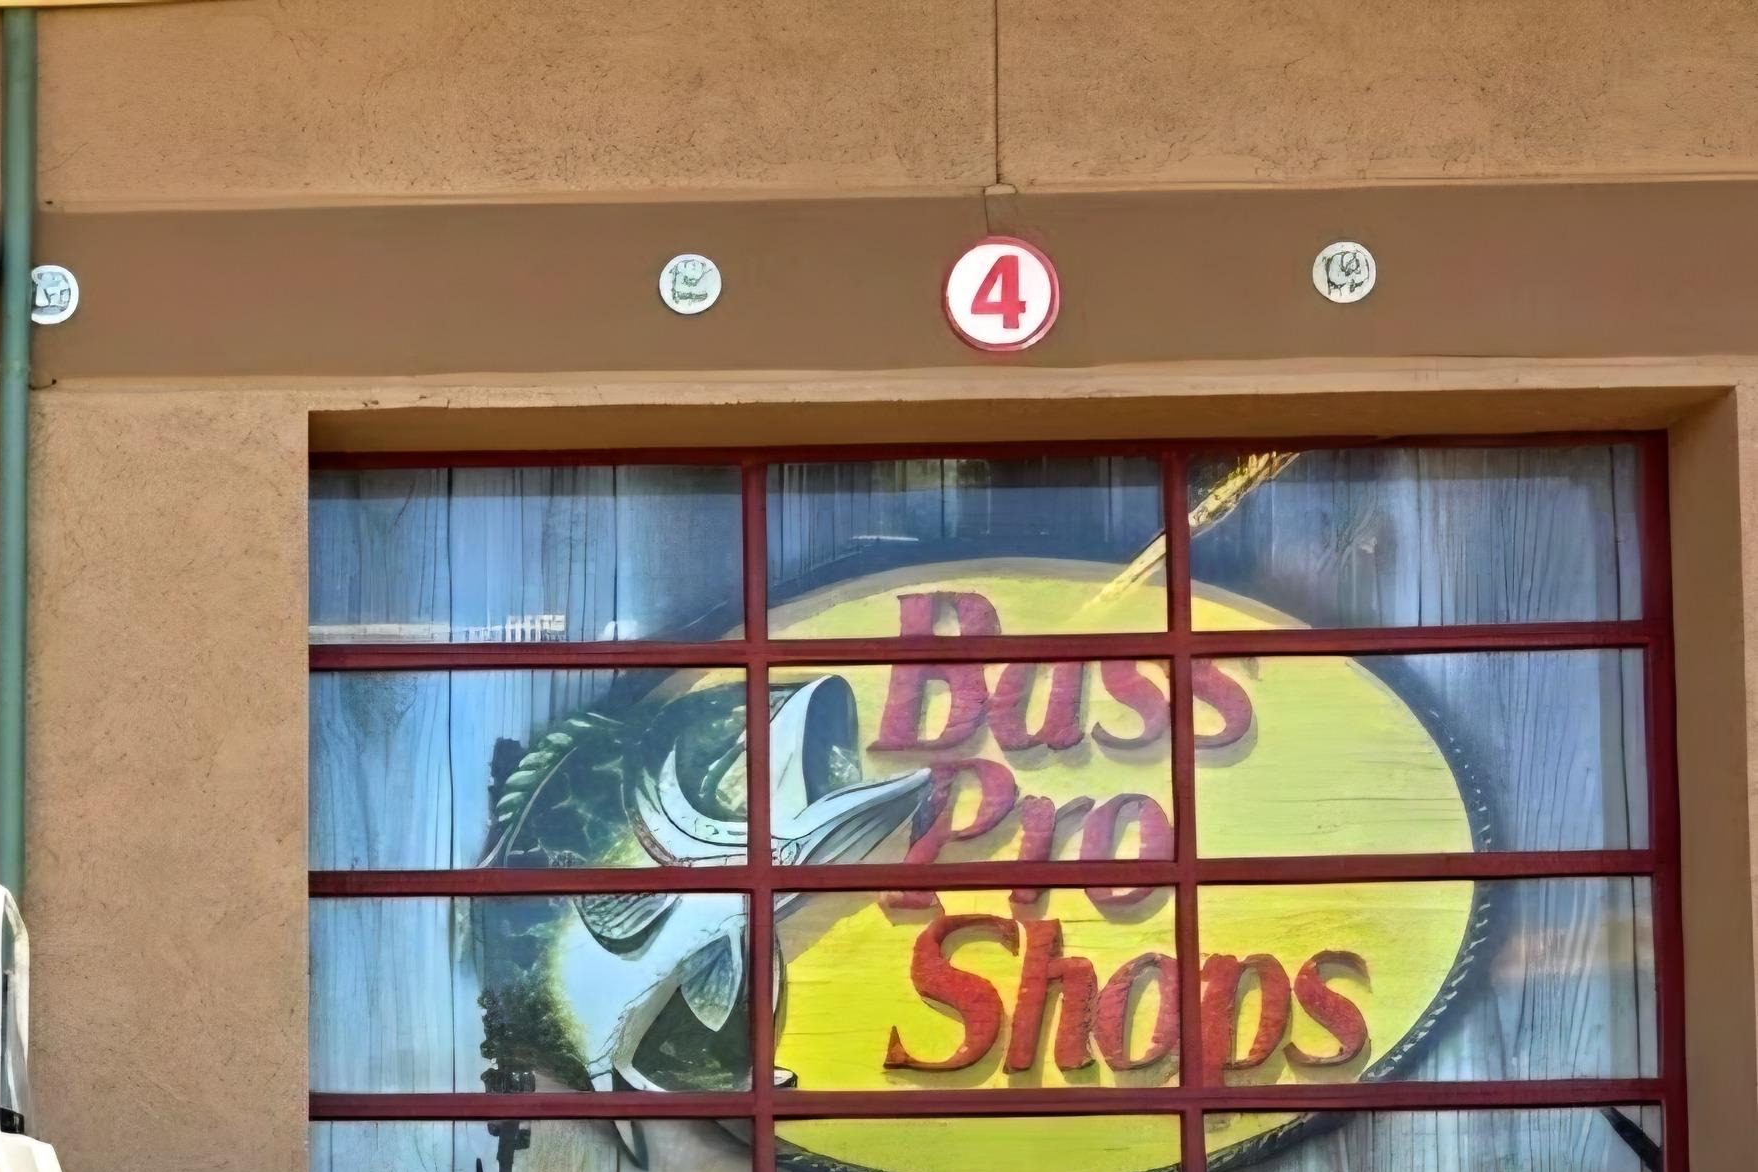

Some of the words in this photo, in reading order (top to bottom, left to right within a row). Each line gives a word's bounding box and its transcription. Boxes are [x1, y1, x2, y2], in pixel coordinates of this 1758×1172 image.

[970, 254, 1027, 330] 4
[867, 590, 1254, 751] Bass
[880, 756, 1176, 909] Pro
[882, 913, 1372, 1089] Shops
